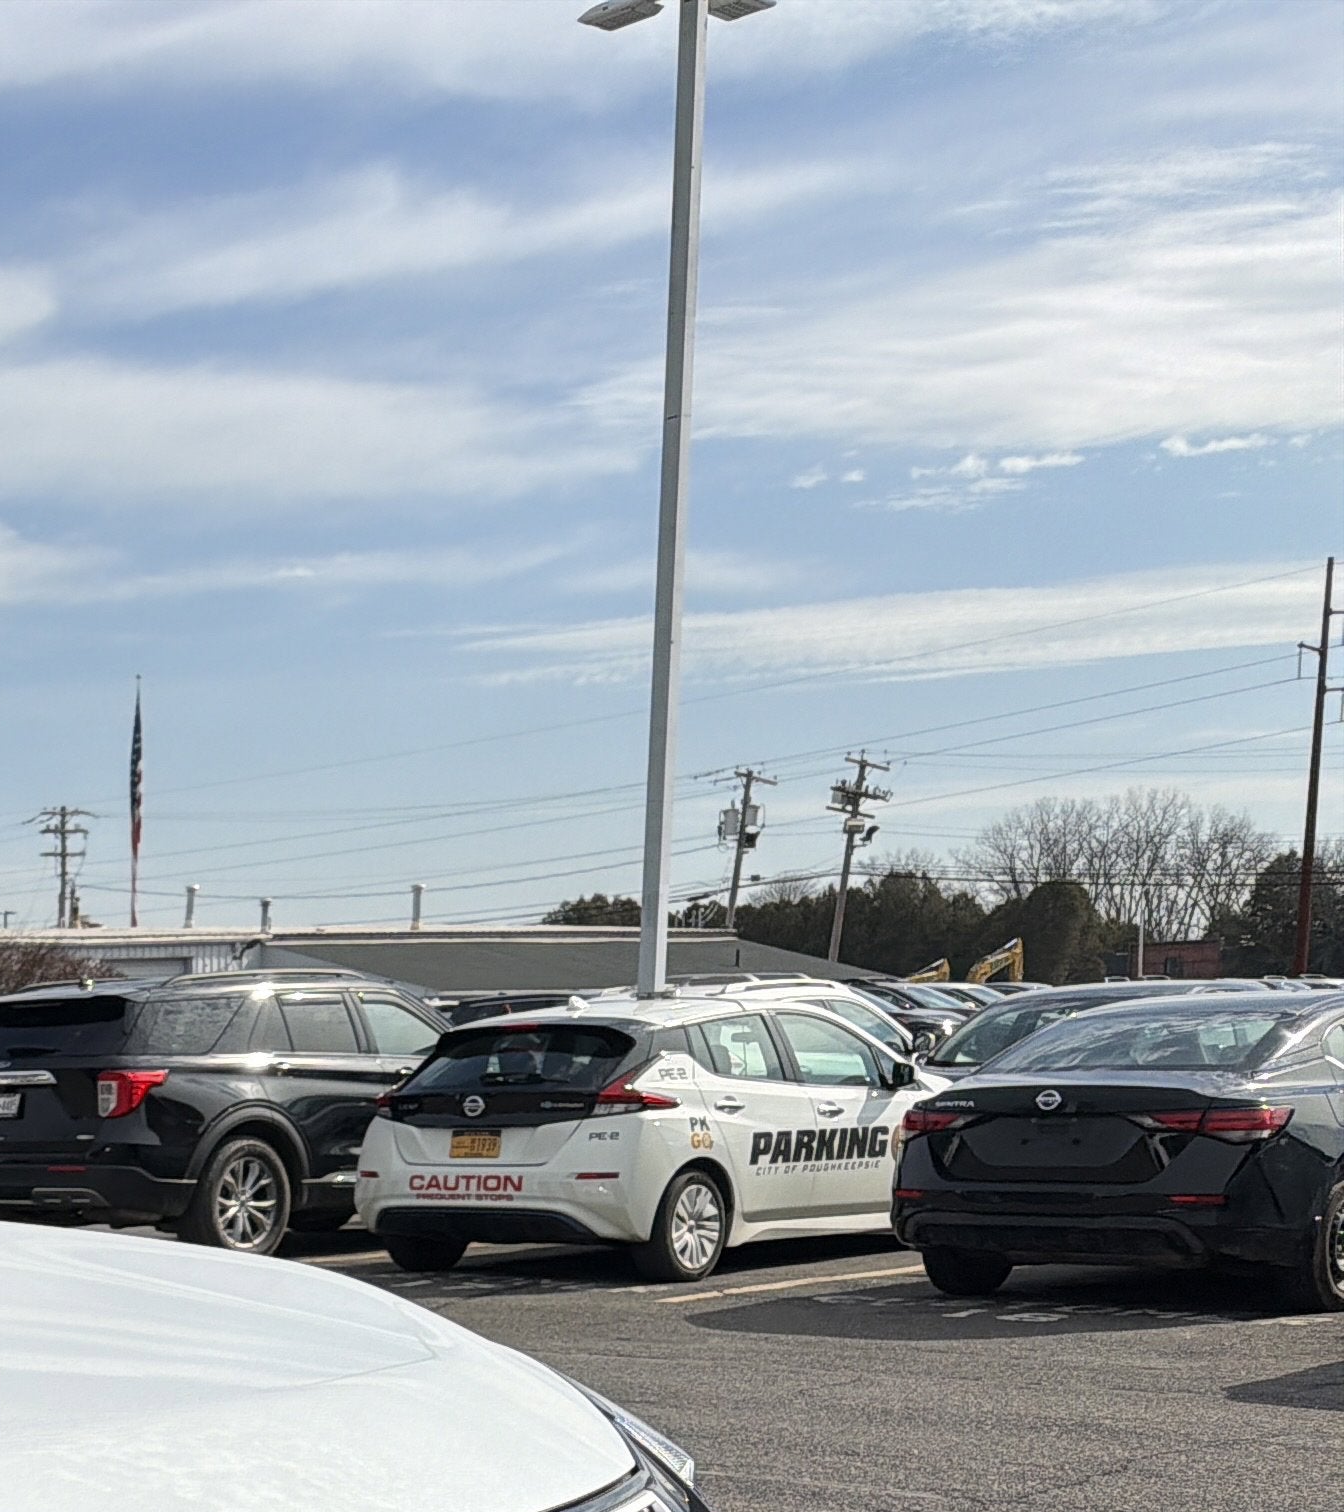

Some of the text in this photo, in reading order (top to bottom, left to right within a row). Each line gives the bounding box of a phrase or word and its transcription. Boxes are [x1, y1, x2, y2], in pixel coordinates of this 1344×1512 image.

[934, 1100, 975, 1108] SENTRA
[749, 1125, 890, 1166] PARKING
[755, 1160, 881, 1177] CITY OF POUGHKEEPSIE
[409, 1174, 524, 1192] CAUTION
[416, 1193, 514, 1202] FREQUENT STOPS
